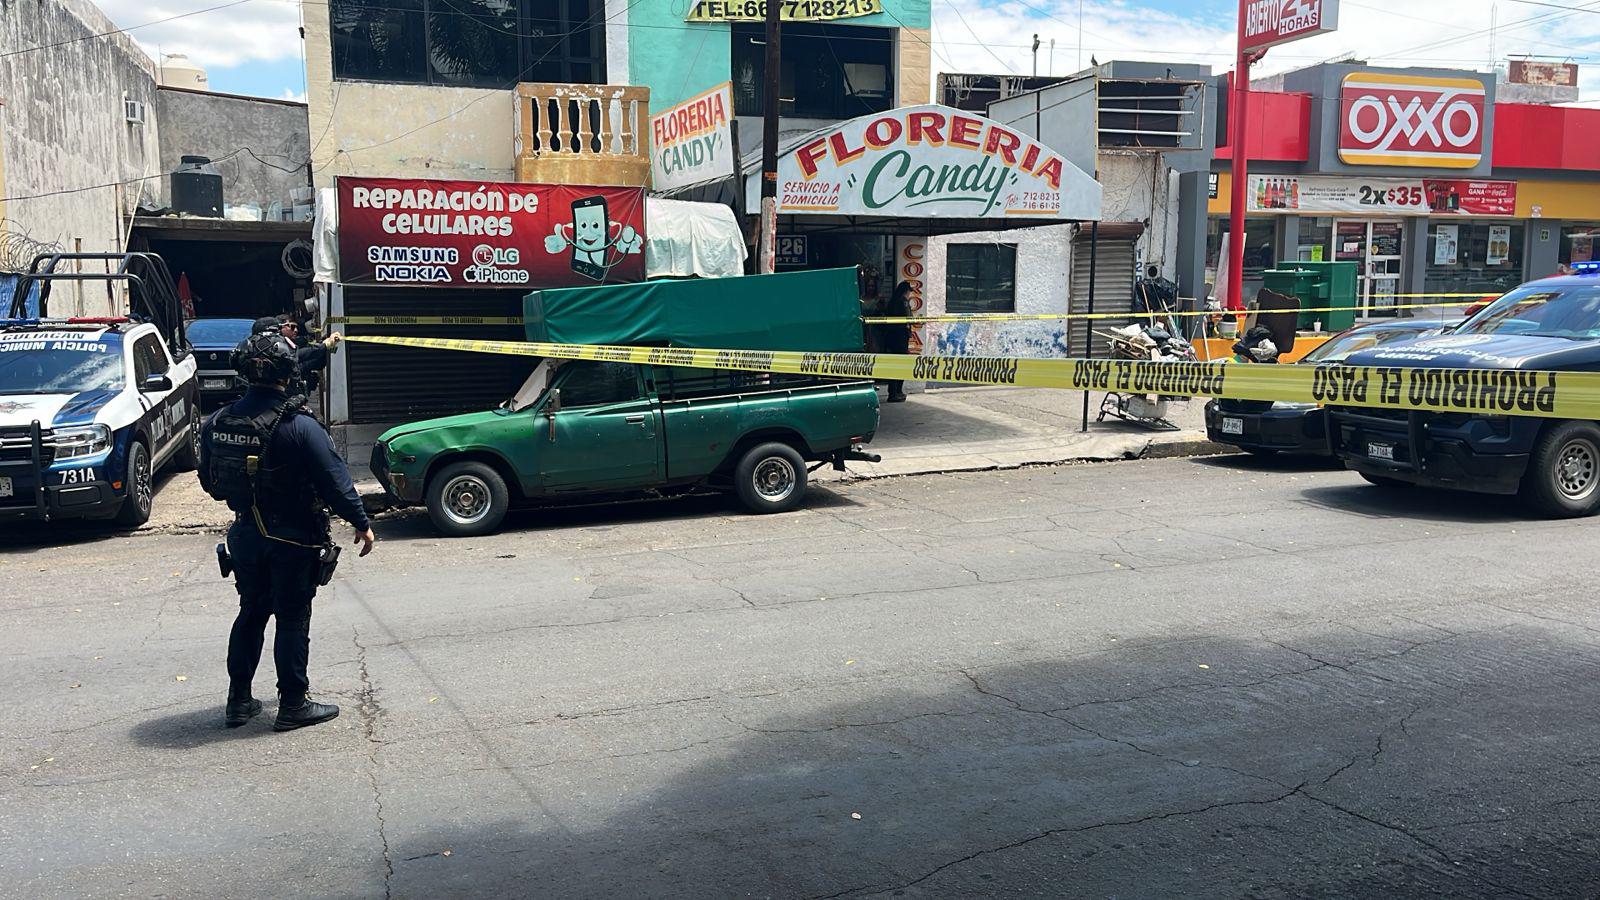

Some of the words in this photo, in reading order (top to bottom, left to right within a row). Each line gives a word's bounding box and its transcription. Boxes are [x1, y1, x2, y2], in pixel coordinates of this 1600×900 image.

[1245, 0, 1279, 37] ABIERTO
[1280, 13, 1317, 33] HORAS
[654, 93, 725, 145] FLORERIA
[1348, 94, 1479, 151] OXXO
[796, 112, 1064, 187] FLORERIA
[783, 194, 840, 206] DOMICILIO
[784, 182, 830, 194] SERVICIO
[833, 182, 841, 194] A
[1359, 185, 1421, 205] 2x$35
[369, 247, 457, 263] SAMSUNG
[497, 248, 517, 263] LG
[377, 266, 451, 281] NOKIA
[479, 265, 527, 281] iPhone
[913, 356, 938, 380] PASO
[941, 357, 952, 380] EL
[954, 358, 1018, 384] PROHIBIDO
[1073, 361, 1109, 389] PASO
[1113, 362, 1132, 389] EL
[1134, 364, 1226, 396] PROHIBIDO
[1313, 366, 1367, 403] PASO
[1375, 368, 1403, 404] EL
[1409, 369, 1556, 413] PROHIBIDO
[213, 432, 261, 445] POLICIA
[58, 468, 96, 484] 731A
